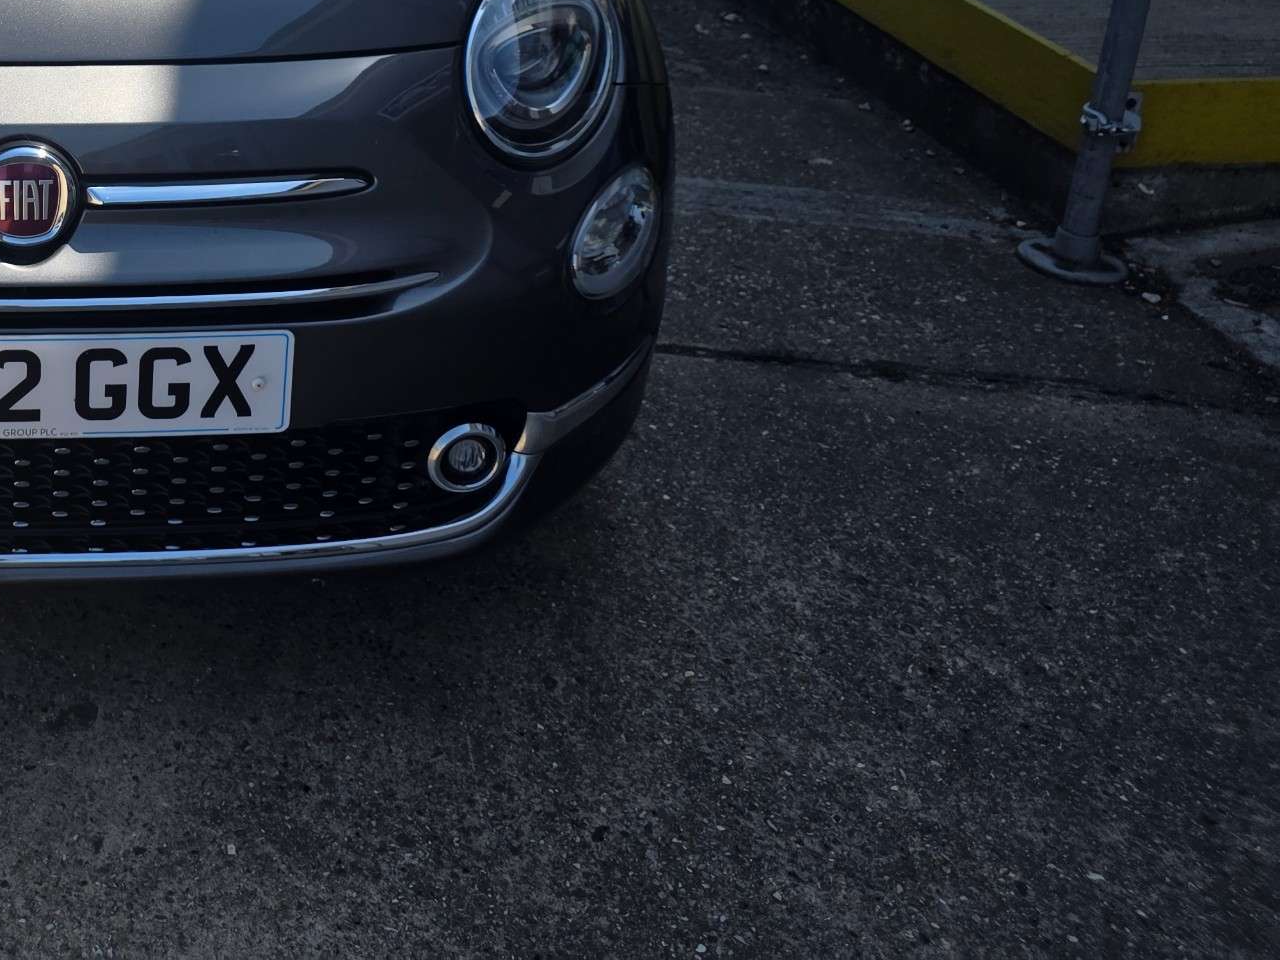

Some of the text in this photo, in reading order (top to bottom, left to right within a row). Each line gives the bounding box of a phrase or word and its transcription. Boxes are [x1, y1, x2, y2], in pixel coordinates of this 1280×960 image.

[0, 179, 54, 221] FIAT
[74, 343, 256, 421] GGX
[2, 427, 38, 437] GROUP
[40, 427, 57, 437] PLC
